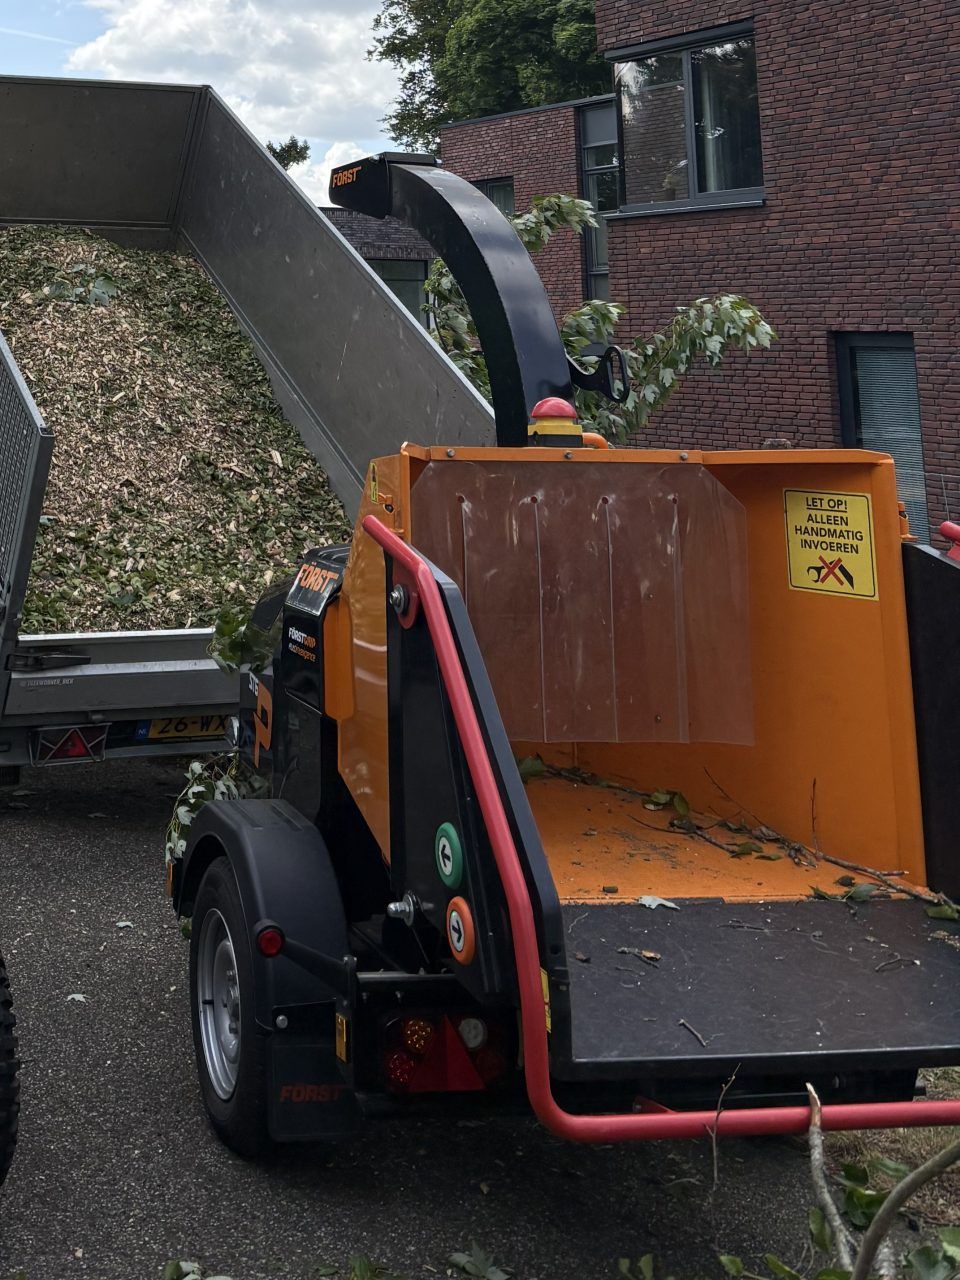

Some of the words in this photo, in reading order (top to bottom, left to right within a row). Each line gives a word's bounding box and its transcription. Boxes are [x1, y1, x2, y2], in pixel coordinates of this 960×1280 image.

[806, 497, 824, 508] LET
[827, 499, 847, 510] OP!
[807, 513, 849, 527] ALLEEN
[795, 525, 864, 541] HANDMATIG
[800, 539, 859, 554] INVOEREN
